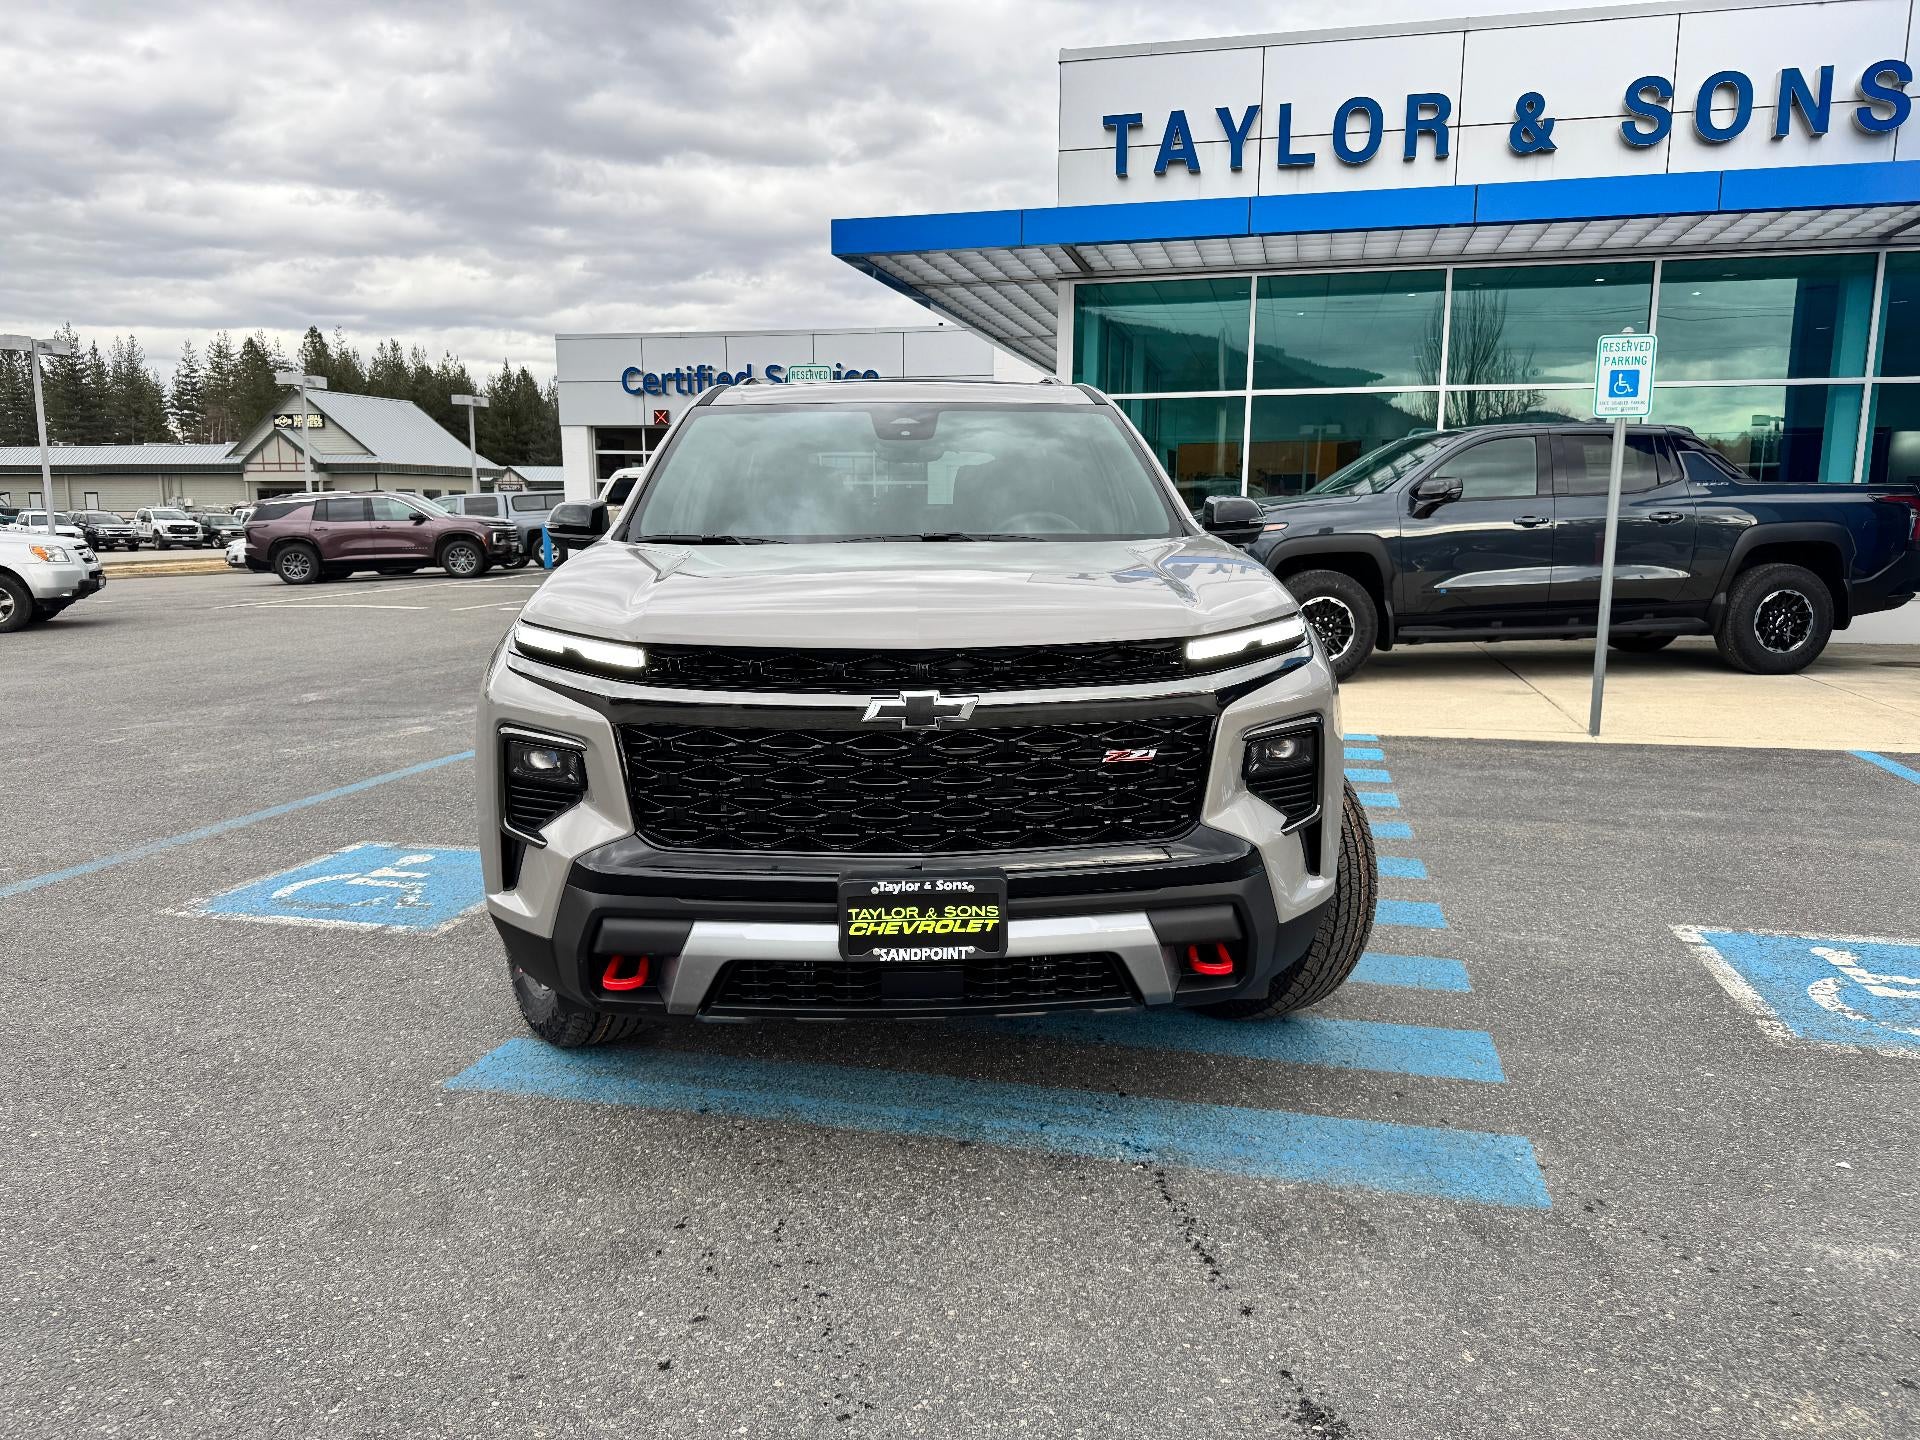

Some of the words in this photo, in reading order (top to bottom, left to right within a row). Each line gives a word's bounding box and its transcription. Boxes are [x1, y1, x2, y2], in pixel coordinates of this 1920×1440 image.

[1102, 92, 1452, 177] TAYLOR
[1509, 91, 1557, 154] &
[1618, 59, 1914, 148] SONS
[1602, 341, 1651, 352] RESERVED
[1603, 355, 1648, 366] PARKING
[791, 370, 828, 380] RESERVED
[878, 880, 921, 894] Taylor
[924, 881, 932, 890] &
[935, 879, 969, 891] Sons
[848, 906, 919, 921] TAYLOR
[925, 907, 938, 920] &
[944, 905, 1000, 918] SONS
[848, 919, 1000, 936] CHEVROLET
[879, 946, 969, 962] SANDPOINT
